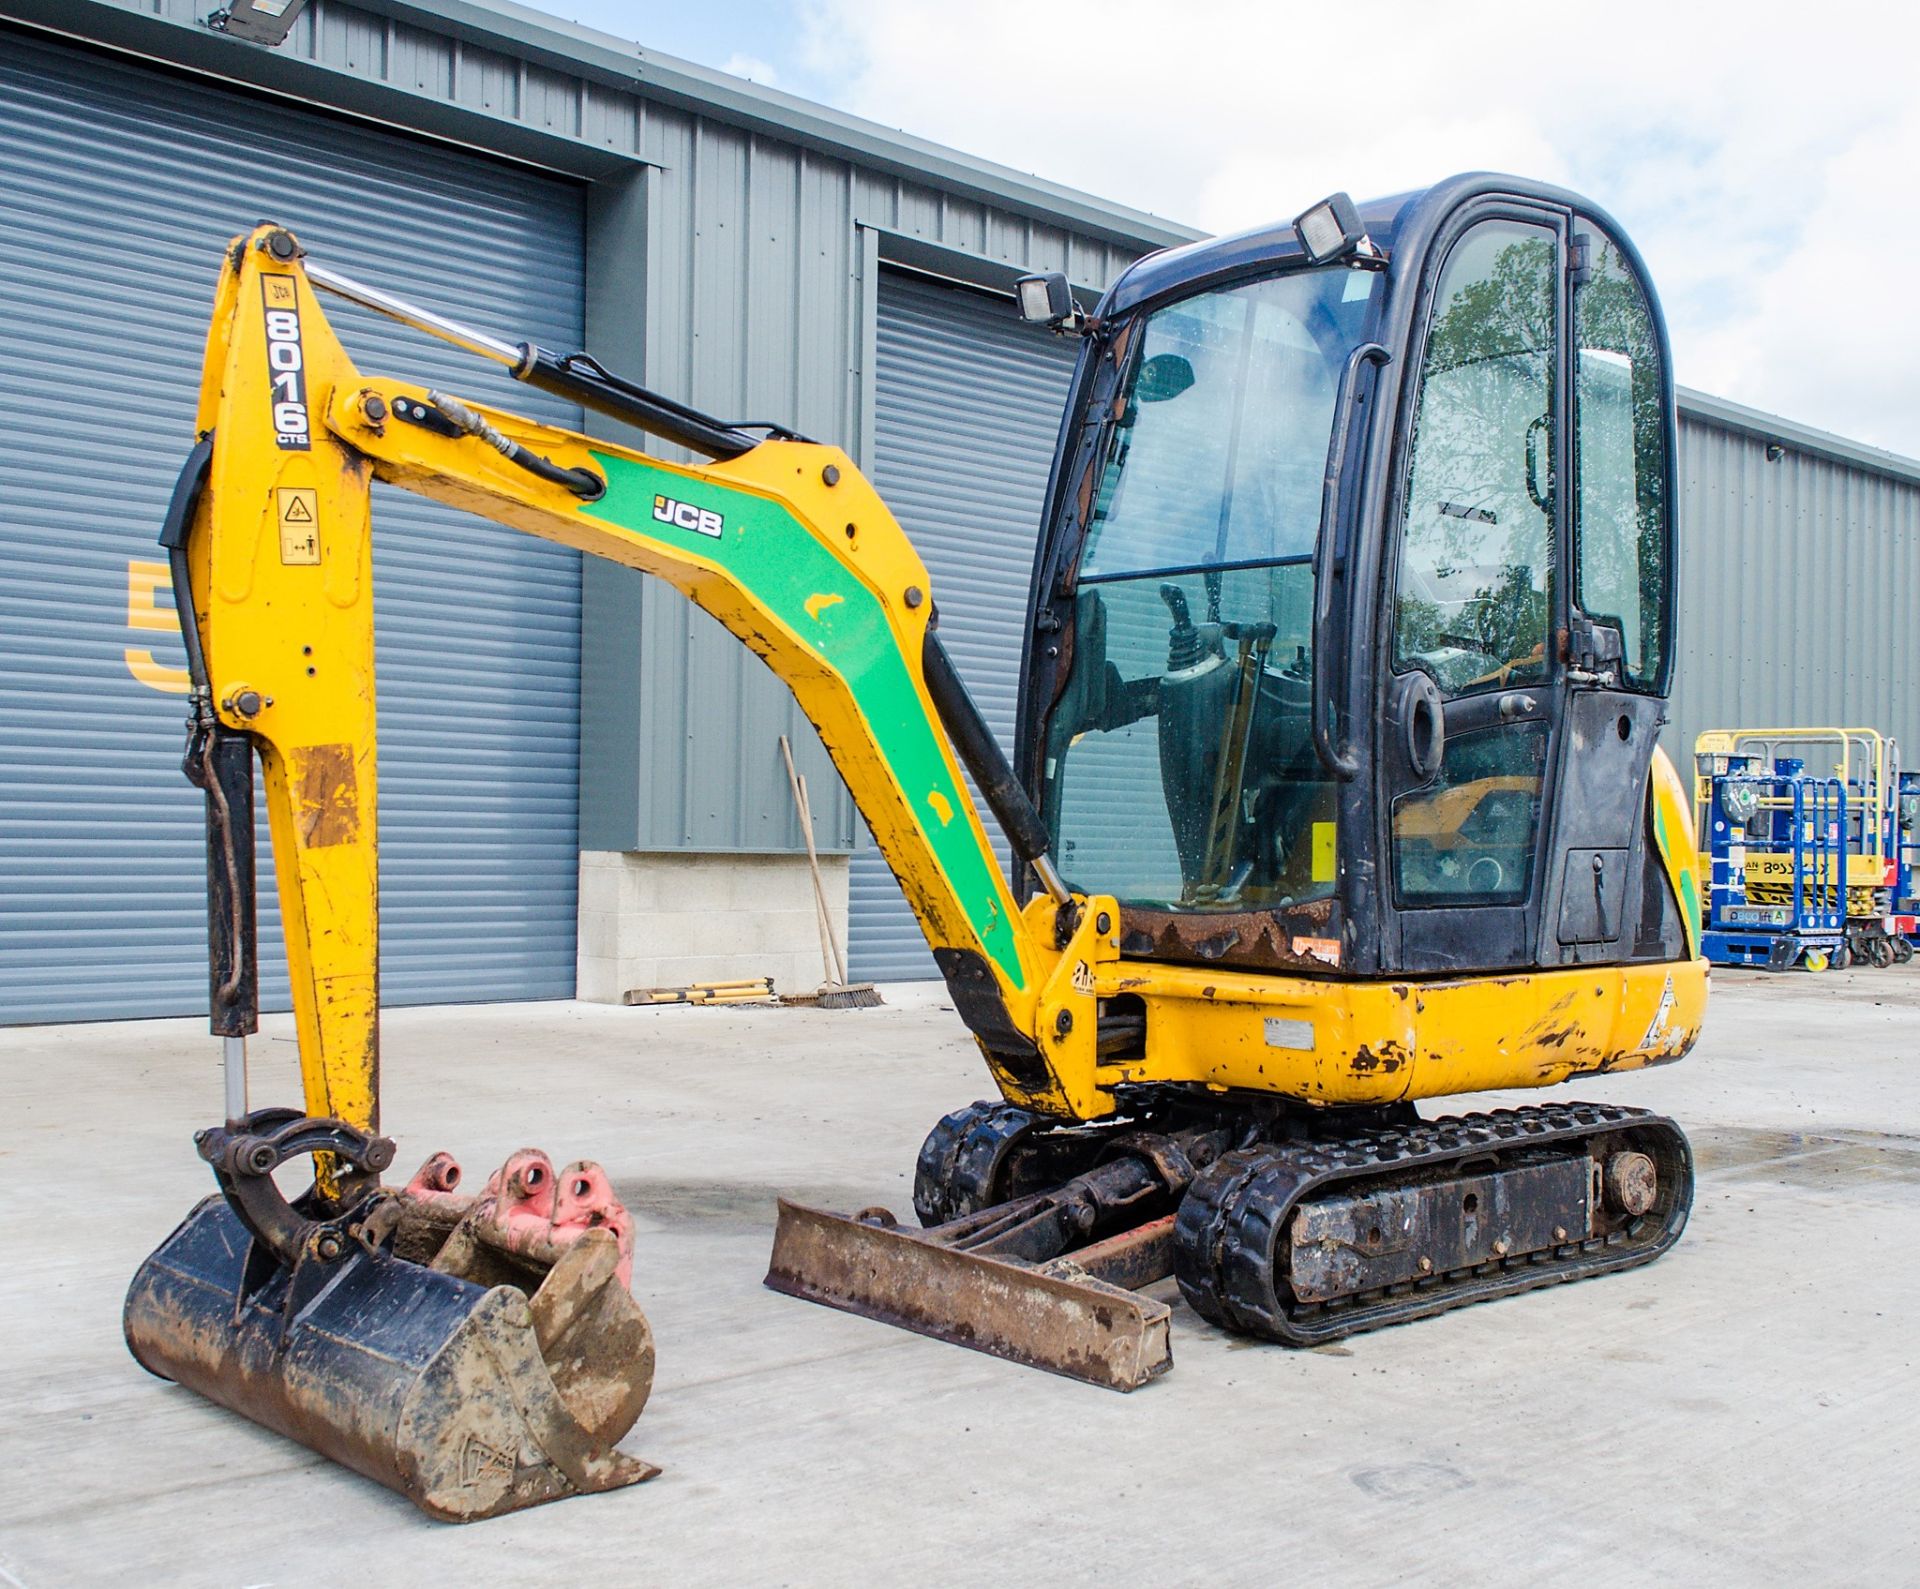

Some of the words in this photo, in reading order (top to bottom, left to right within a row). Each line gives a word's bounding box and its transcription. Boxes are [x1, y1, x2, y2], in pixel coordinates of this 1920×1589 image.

[266, 311, 308, 434] 8016
[277, 433, 308, 444] CTS
[653, 497, 723, 537] JCB
